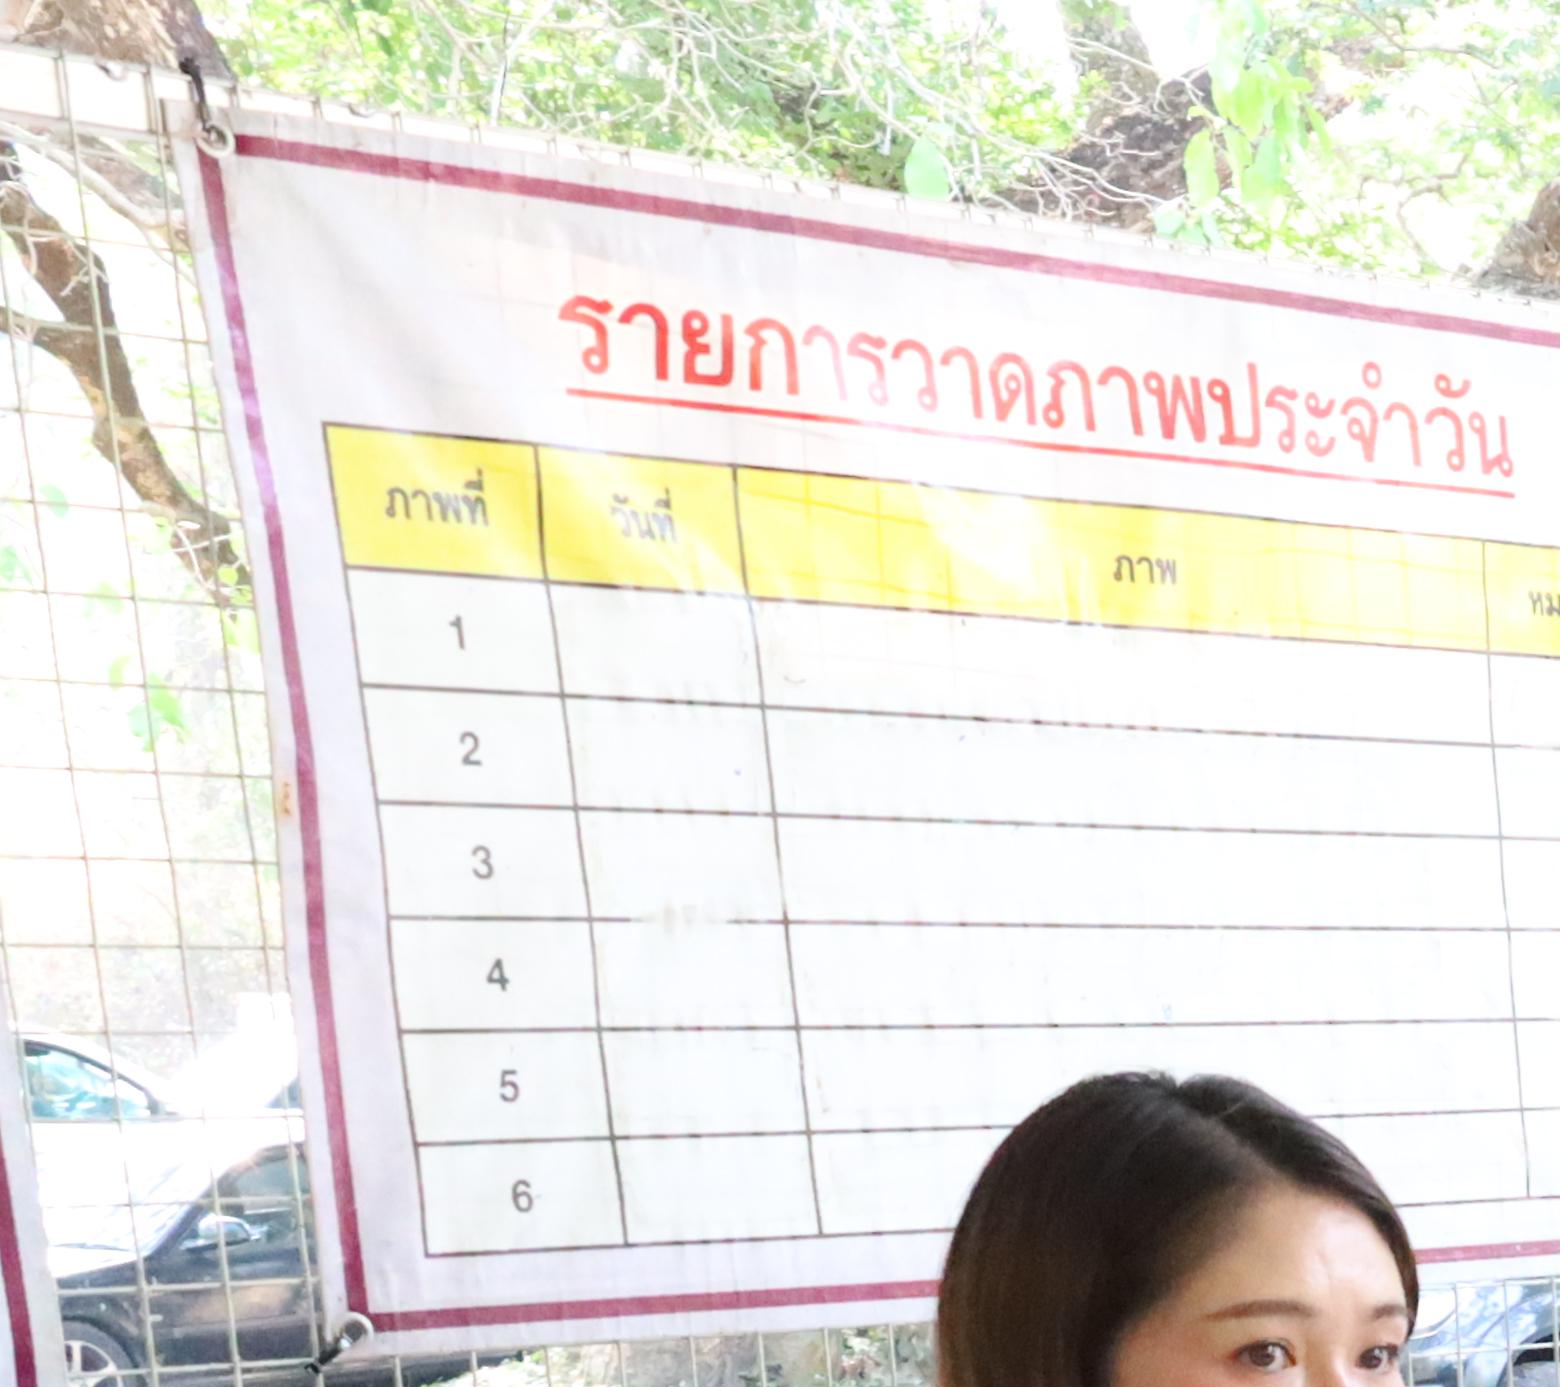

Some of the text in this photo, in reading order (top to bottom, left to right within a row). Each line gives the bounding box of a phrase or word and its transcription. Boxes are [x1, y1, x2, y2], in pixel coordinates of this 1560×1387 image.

[558, 294, 1516, 480] รายการวาดภาพประจำวัน
[384, 467, 491, 529] ภาพที่
[609, 486, 678, 544] วันที่
[1112, 549, 1179, 587] ภาพ
[447, 614, 468, 651] 1
[459, 732, 483, 768] 2
[471, 846, 494, 880] 3
[486, 958, 510, 993] 4
[498, 1069, 521, 1103] 5
[511, 1179, 535, 1214] 6
